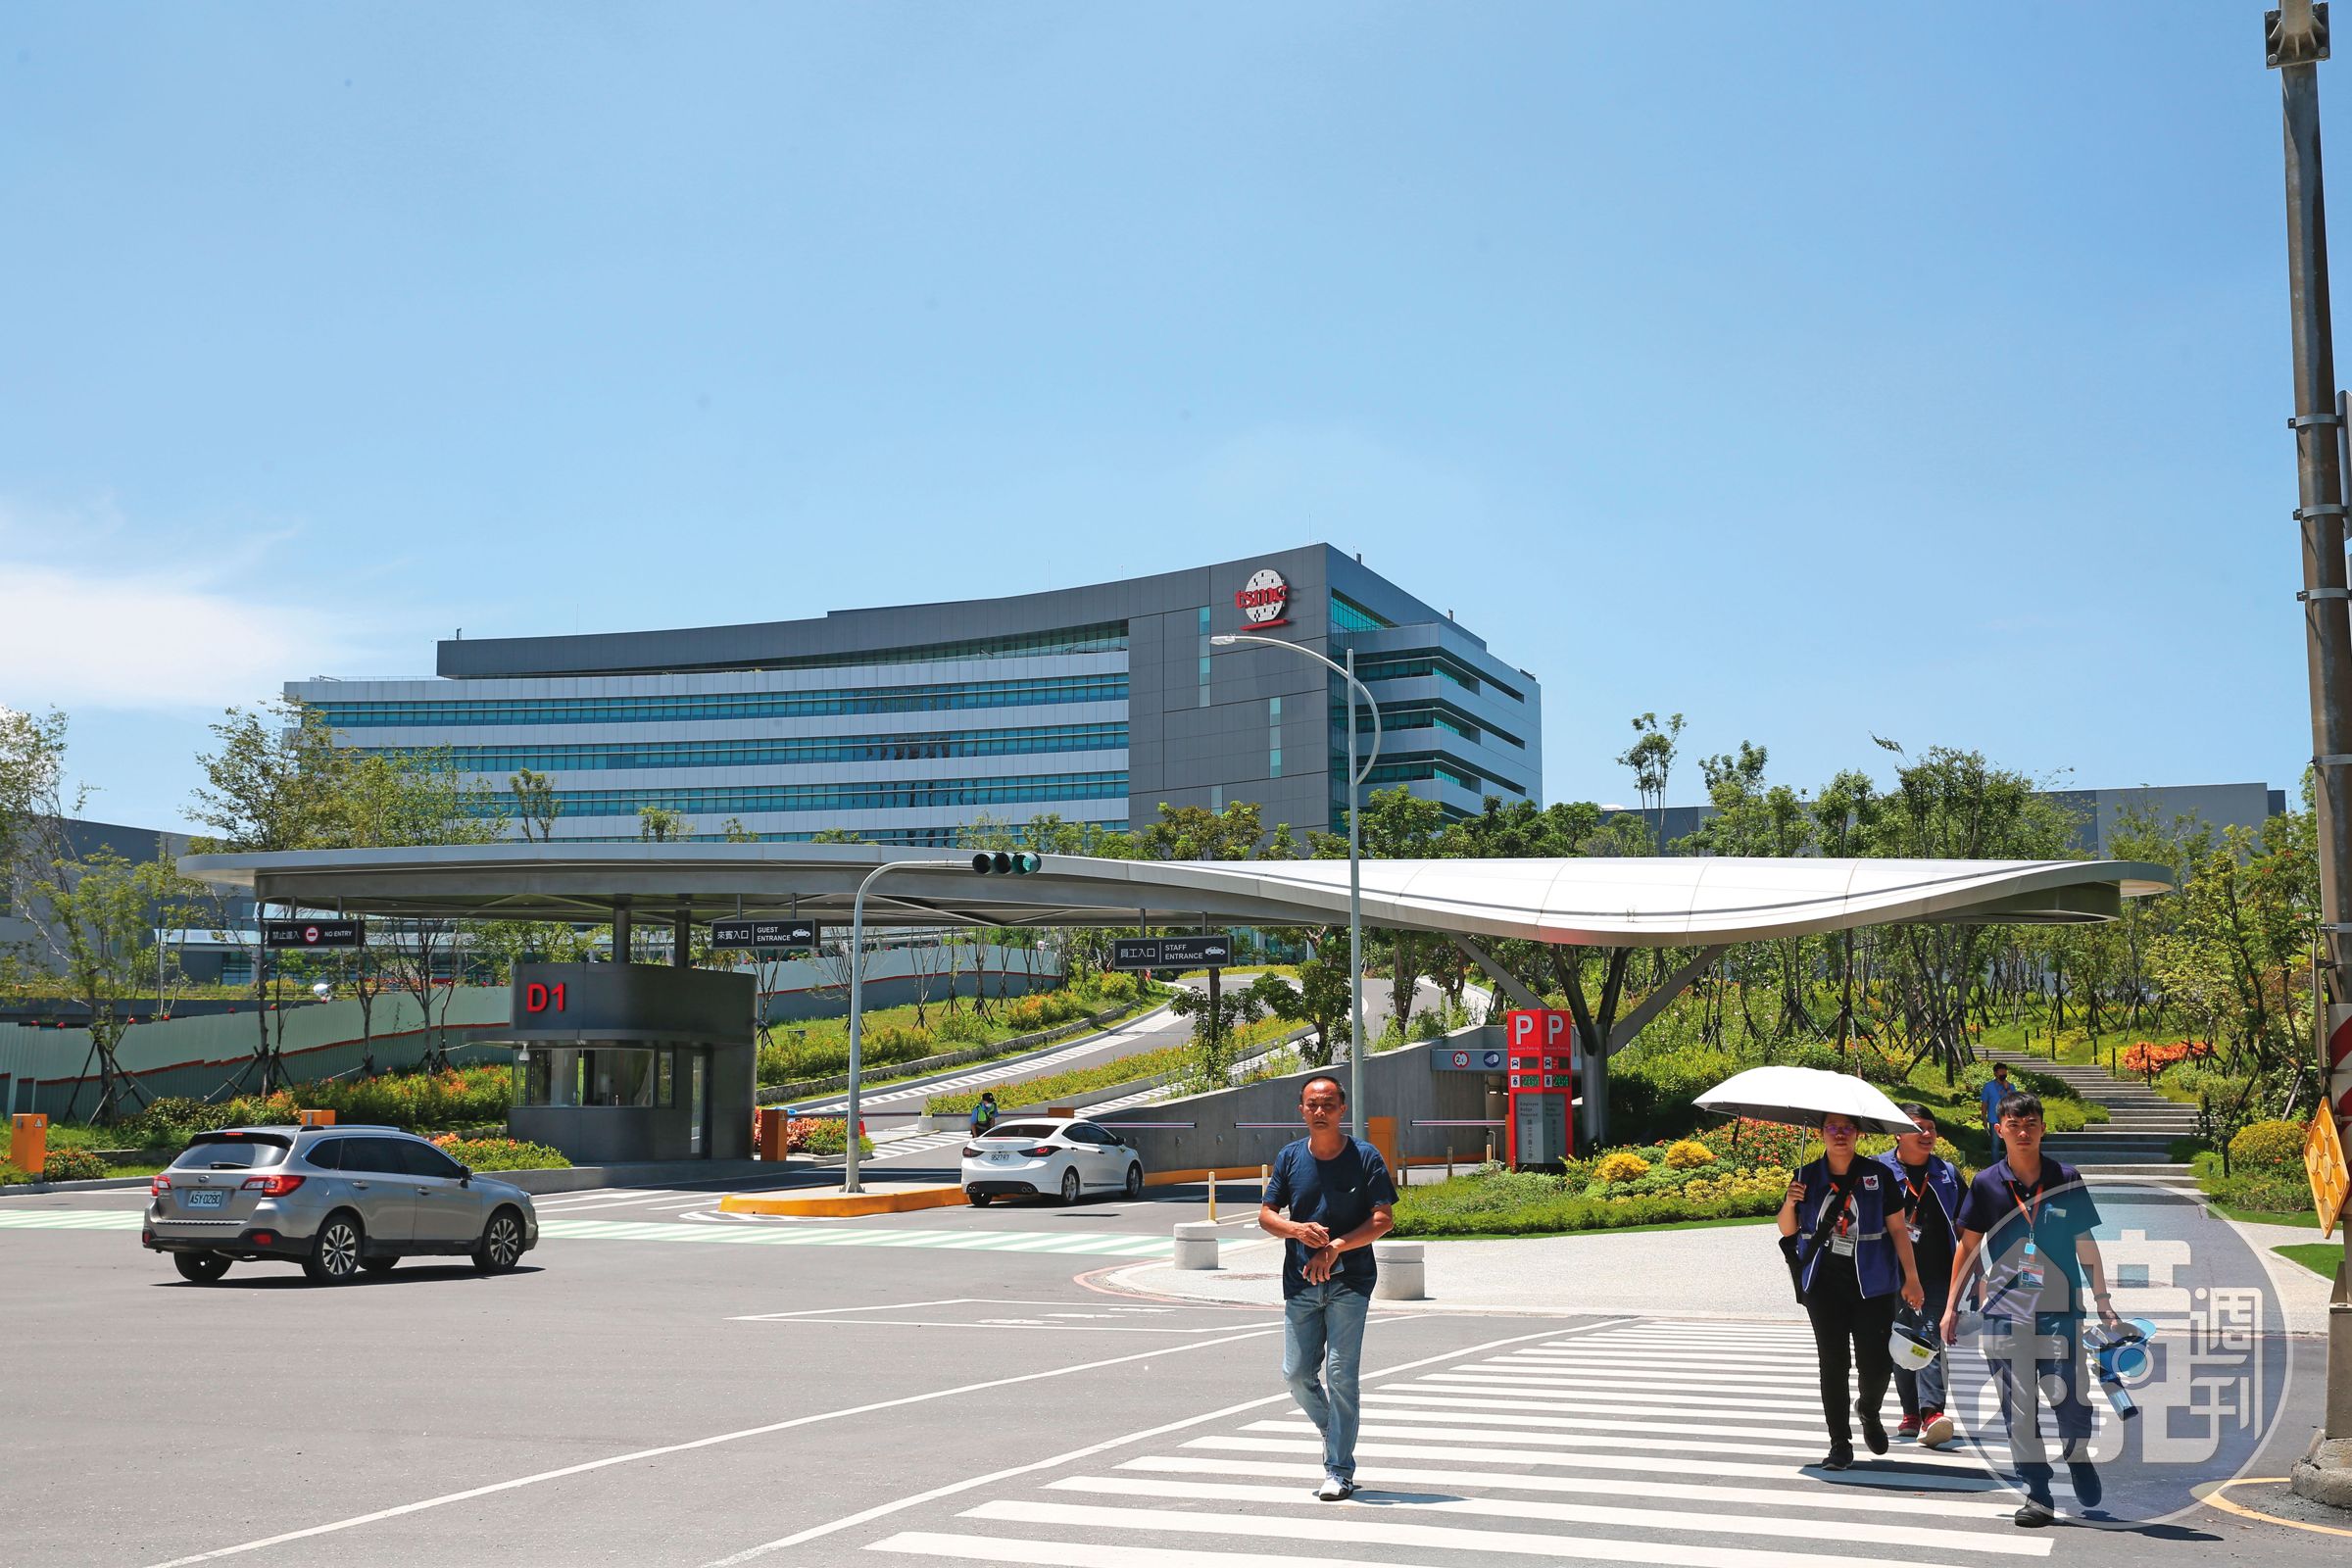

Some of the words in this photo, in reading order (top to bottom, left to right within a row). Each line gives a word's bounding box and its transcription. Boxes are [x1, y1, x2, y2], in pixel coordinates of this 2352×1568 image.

[1235, 585, 1288, 609] tsmc
[716, 930, 750, 940] 來賓入口
[1120, 948, 1155, 958] 員工入口
[1164, 952, 1203, 960] ENTRANCE
[526, 982, 565, 1012] D1
[1515, 1014, 1534, 1045] P
[1547, 1014, 1564, 1045] P
